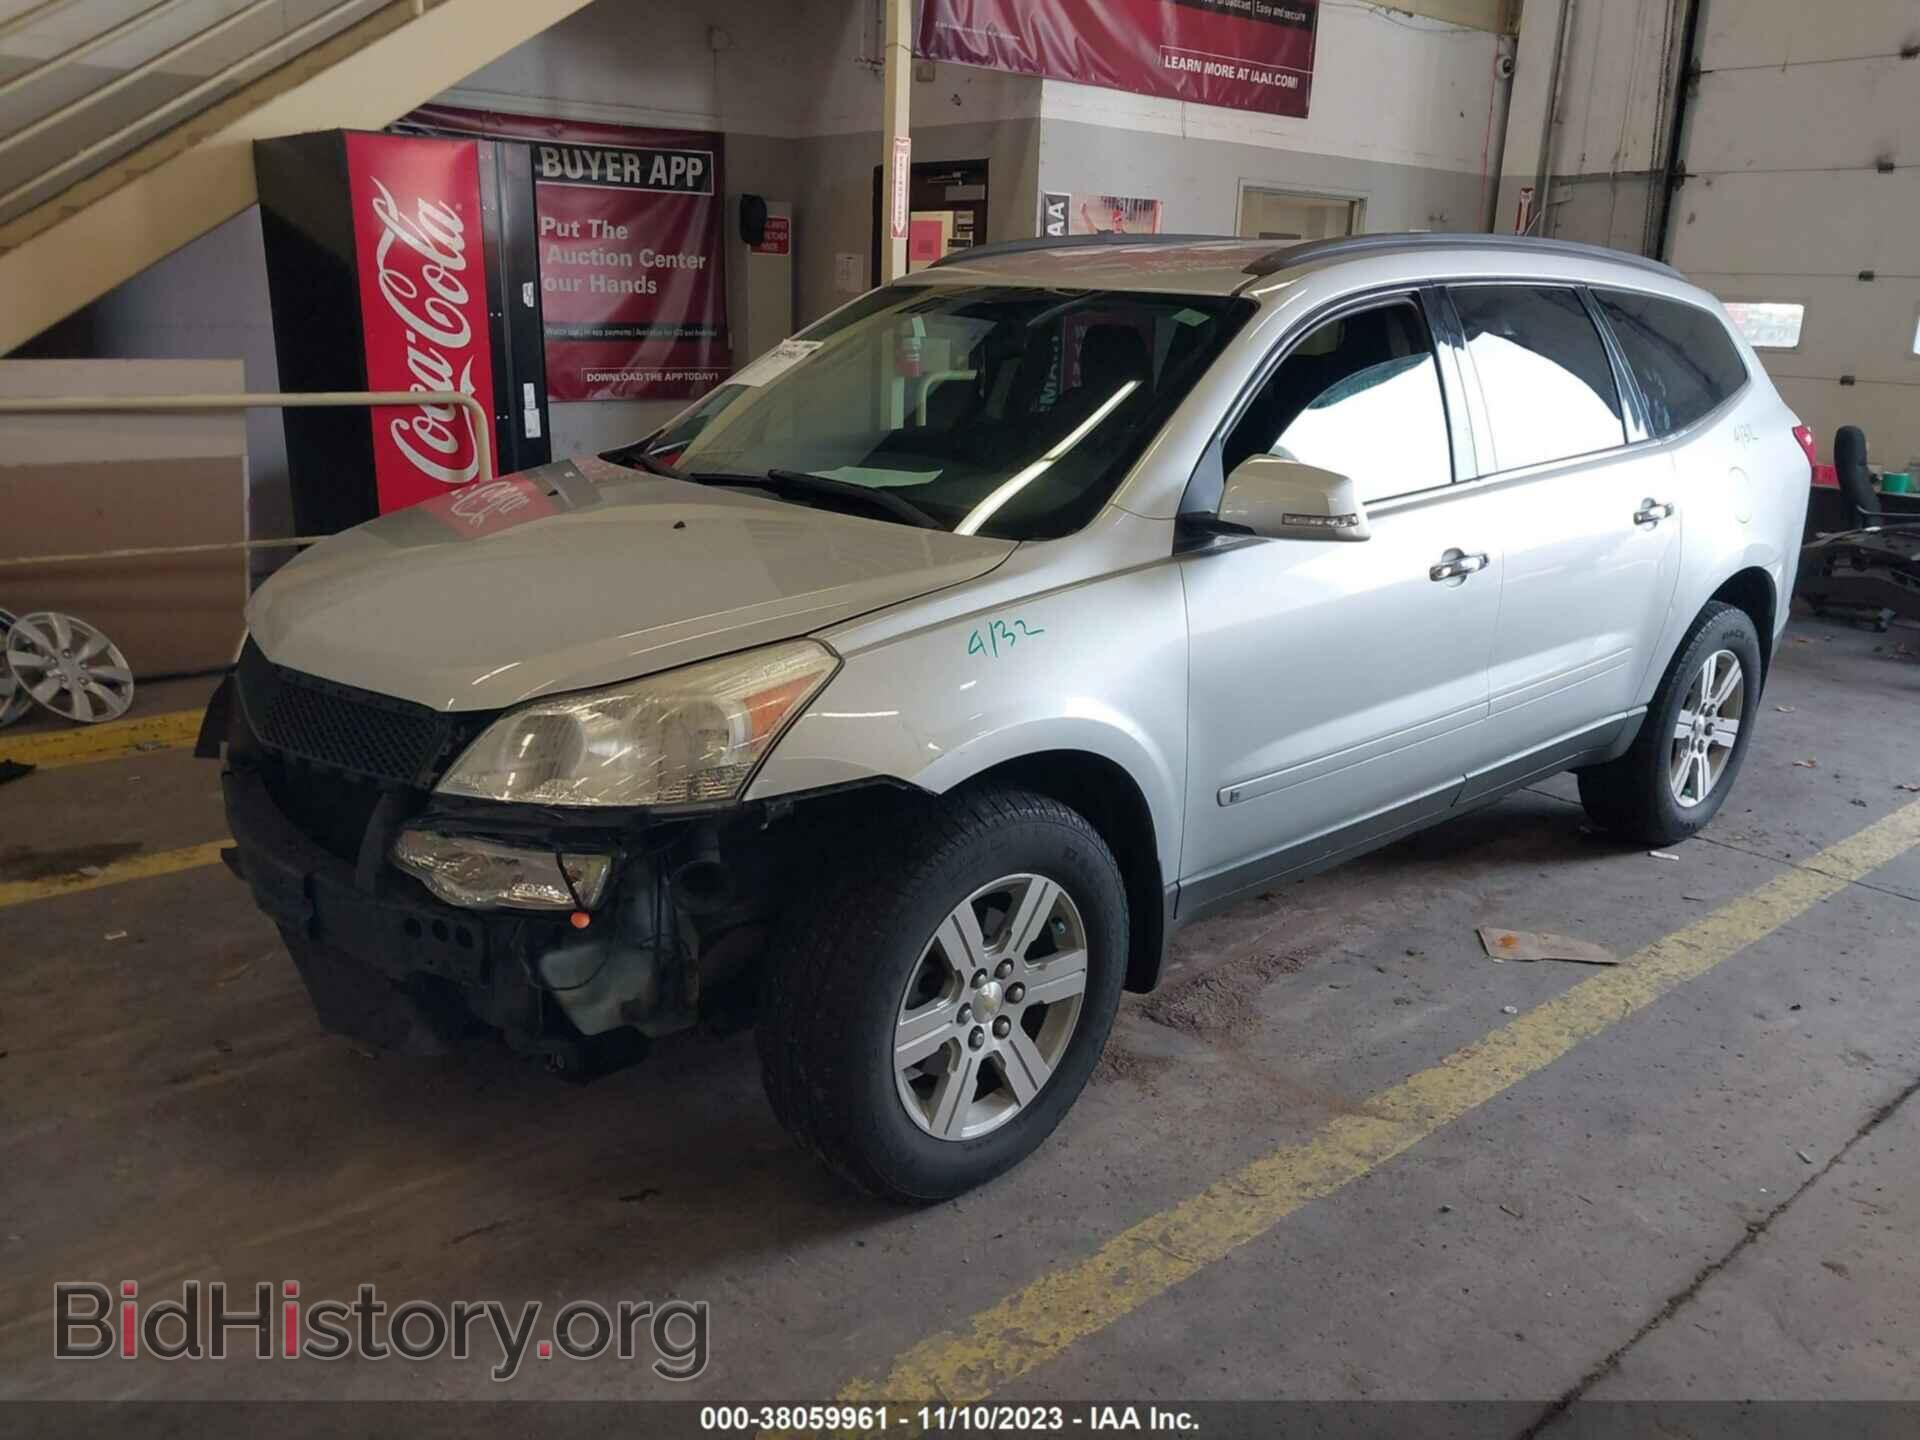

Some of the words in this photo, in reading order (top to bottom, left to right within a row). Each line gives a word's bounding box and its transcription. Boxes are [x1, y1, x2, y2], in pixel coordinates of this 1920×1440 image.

[1256, 1, 1272, 16] Easy
[1164, 55, 1202, 73] LEARN
[1204, 62, 1235, 79] MORE
[1236, 67, 1250, 81] AT
[540, 146, 640, 184] BUYER
[648, 155, 703, 187] APP
[540, 216, 580, 238] Put
[588, 219, 629, 240] The
[547, 245, 632, 268] Auction
[639, 248, 706, 270] Center
[541, 272, 582, 292] our
[590, 273, 657, 294] Hands
[586, 372, 643, 382] DOWNLOAD
[644, 373, 662, 381] THE
[664, 373, 682, 381] APP
[683, 372, 718, 381] TODAY!
